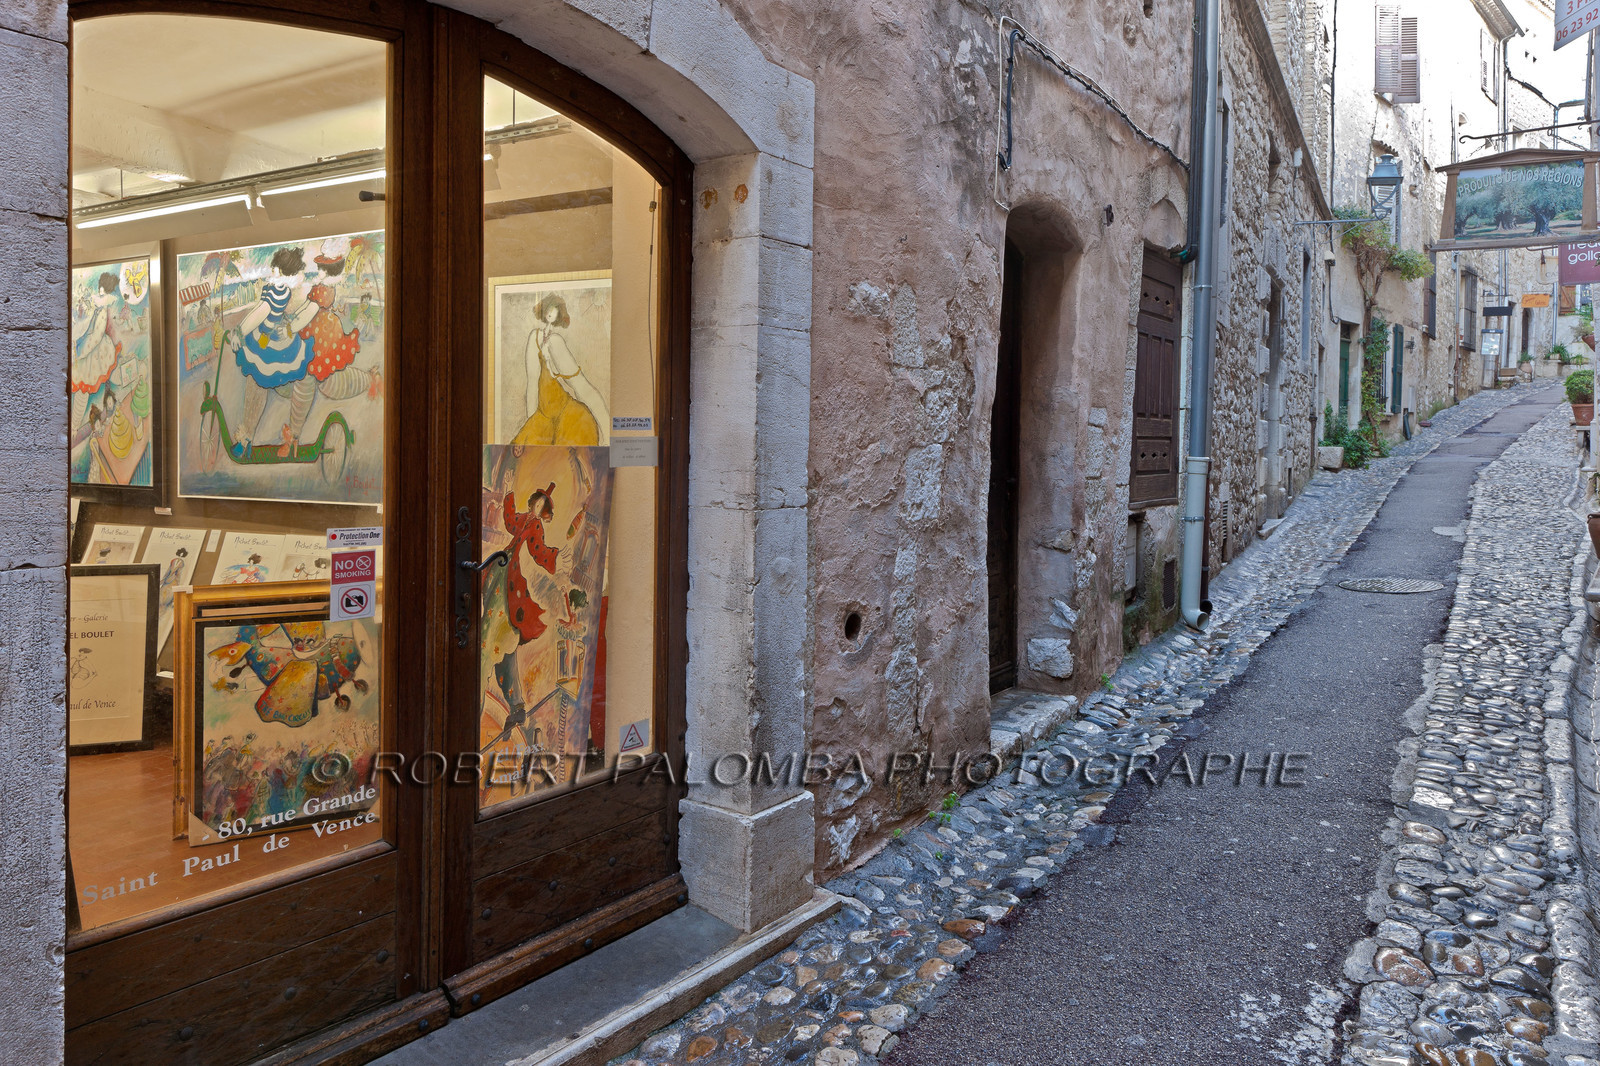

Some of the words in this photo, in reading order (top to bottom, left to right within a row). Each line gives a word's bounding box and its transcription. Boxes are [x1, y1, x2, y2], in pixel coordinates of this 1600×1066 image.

[1556, 26, 1569, 42] 06
[1570, 18, 1583, 34] 23
[1585, 8, 1599, 25] 92
[1458, 173, 1503, 196] PRODUITS
[1505, 171, 1520, 183] DE
[1519, 169, 1540, 181] NOS
[340, 532, 369, 540] Protection
[369, 531, 381, 539] One
[335, 560, 354, 571] NO
[335, 569, 371, 579] SMOKING
[83, 613, 108, 623] Galerie
[81, 631, 115, 639] BOULET
[82, 699, 92, 710] de
[94, 699, 117, 709] Vence
[217, 817, 254, 840] 80,
[260, 809, 296, 829] rue
[303, 784, 376, 816] Grande
[82, 871, 159, 906] Saint
[182, 844, 241, 878] Paul
[262, 833, 290, 853] de
[311, 810, 376, 839] Vence
